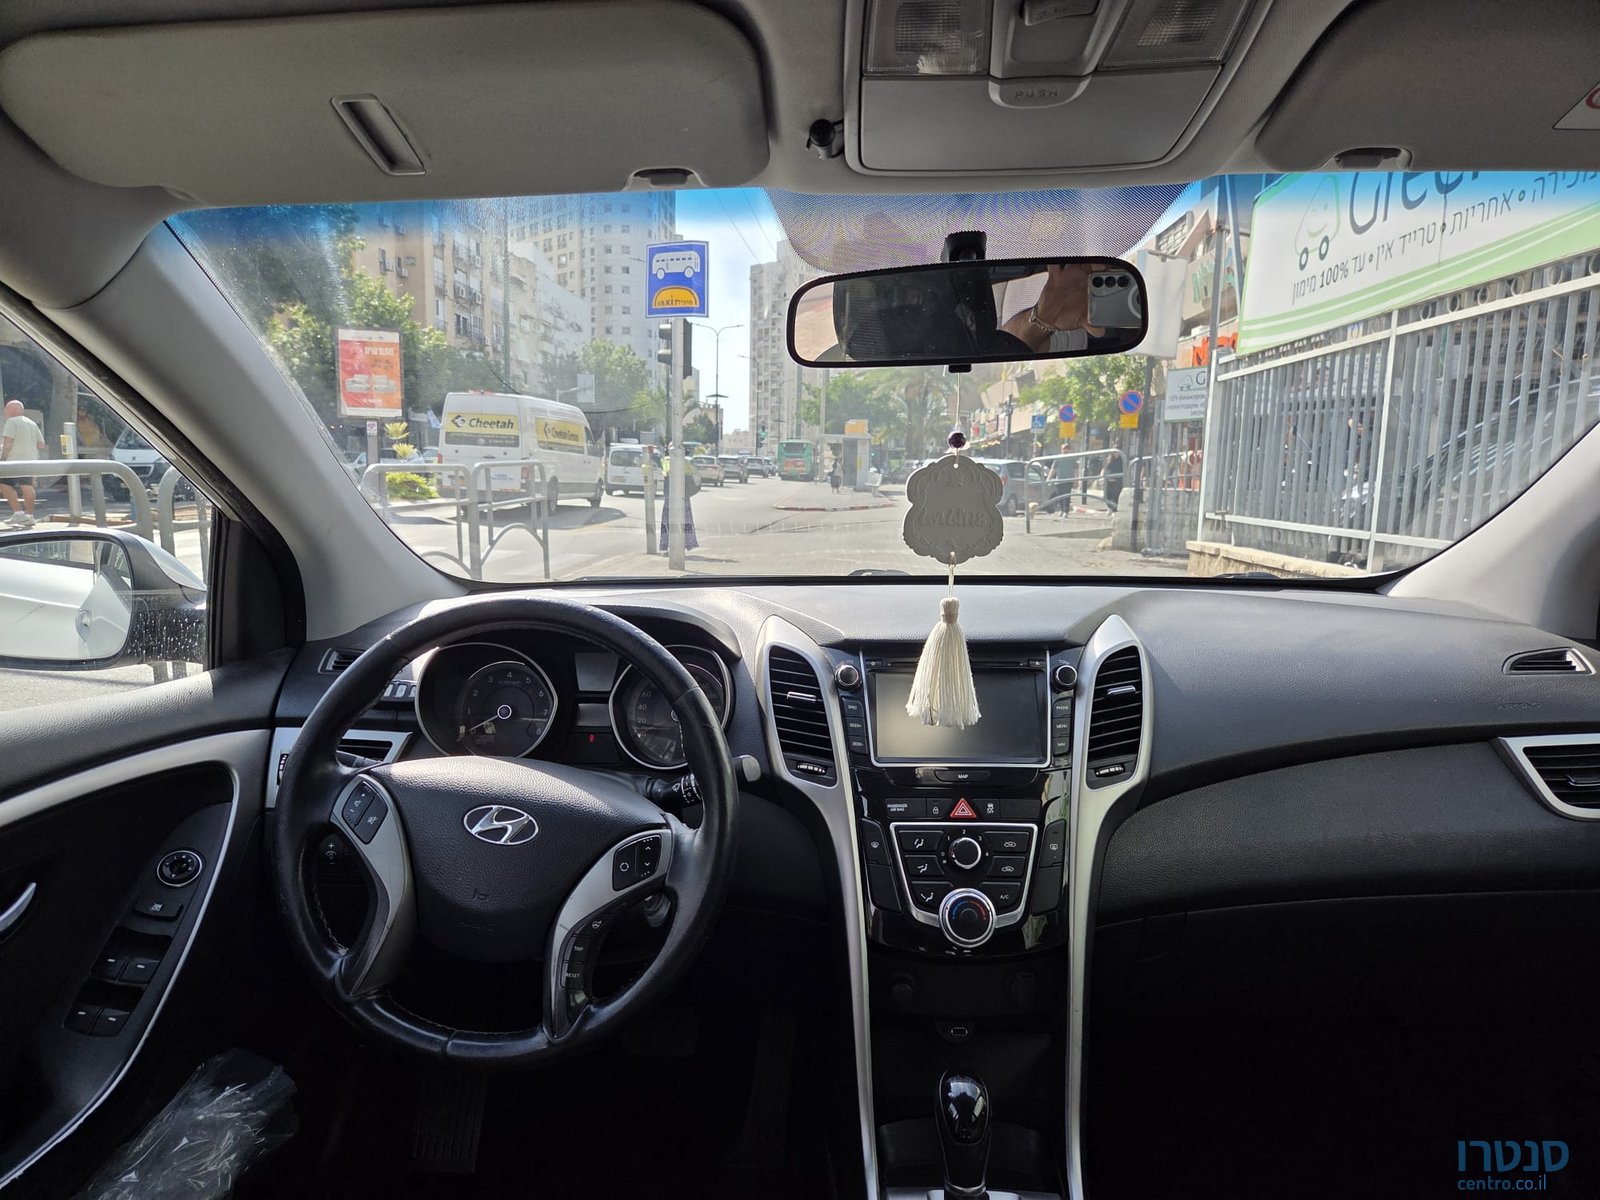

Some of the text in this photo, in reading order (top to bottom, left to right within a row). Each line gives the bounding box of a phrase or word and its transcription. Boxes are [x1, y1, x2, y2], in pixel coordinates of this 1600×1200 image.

[1014, 89, 1058, 98] PUSH
[1450, 188, 1514, 235] אחריות
[1399, 221, 1437, 255] טרייד
[1352, 252, 1366, 274] עד
[1375, 239, 1395, 271] אין
[1319, 260, 1349, 289] 100%
[1292, 275, 1317, 305] מימון
[468, 418, 514, 429] Cheetah
